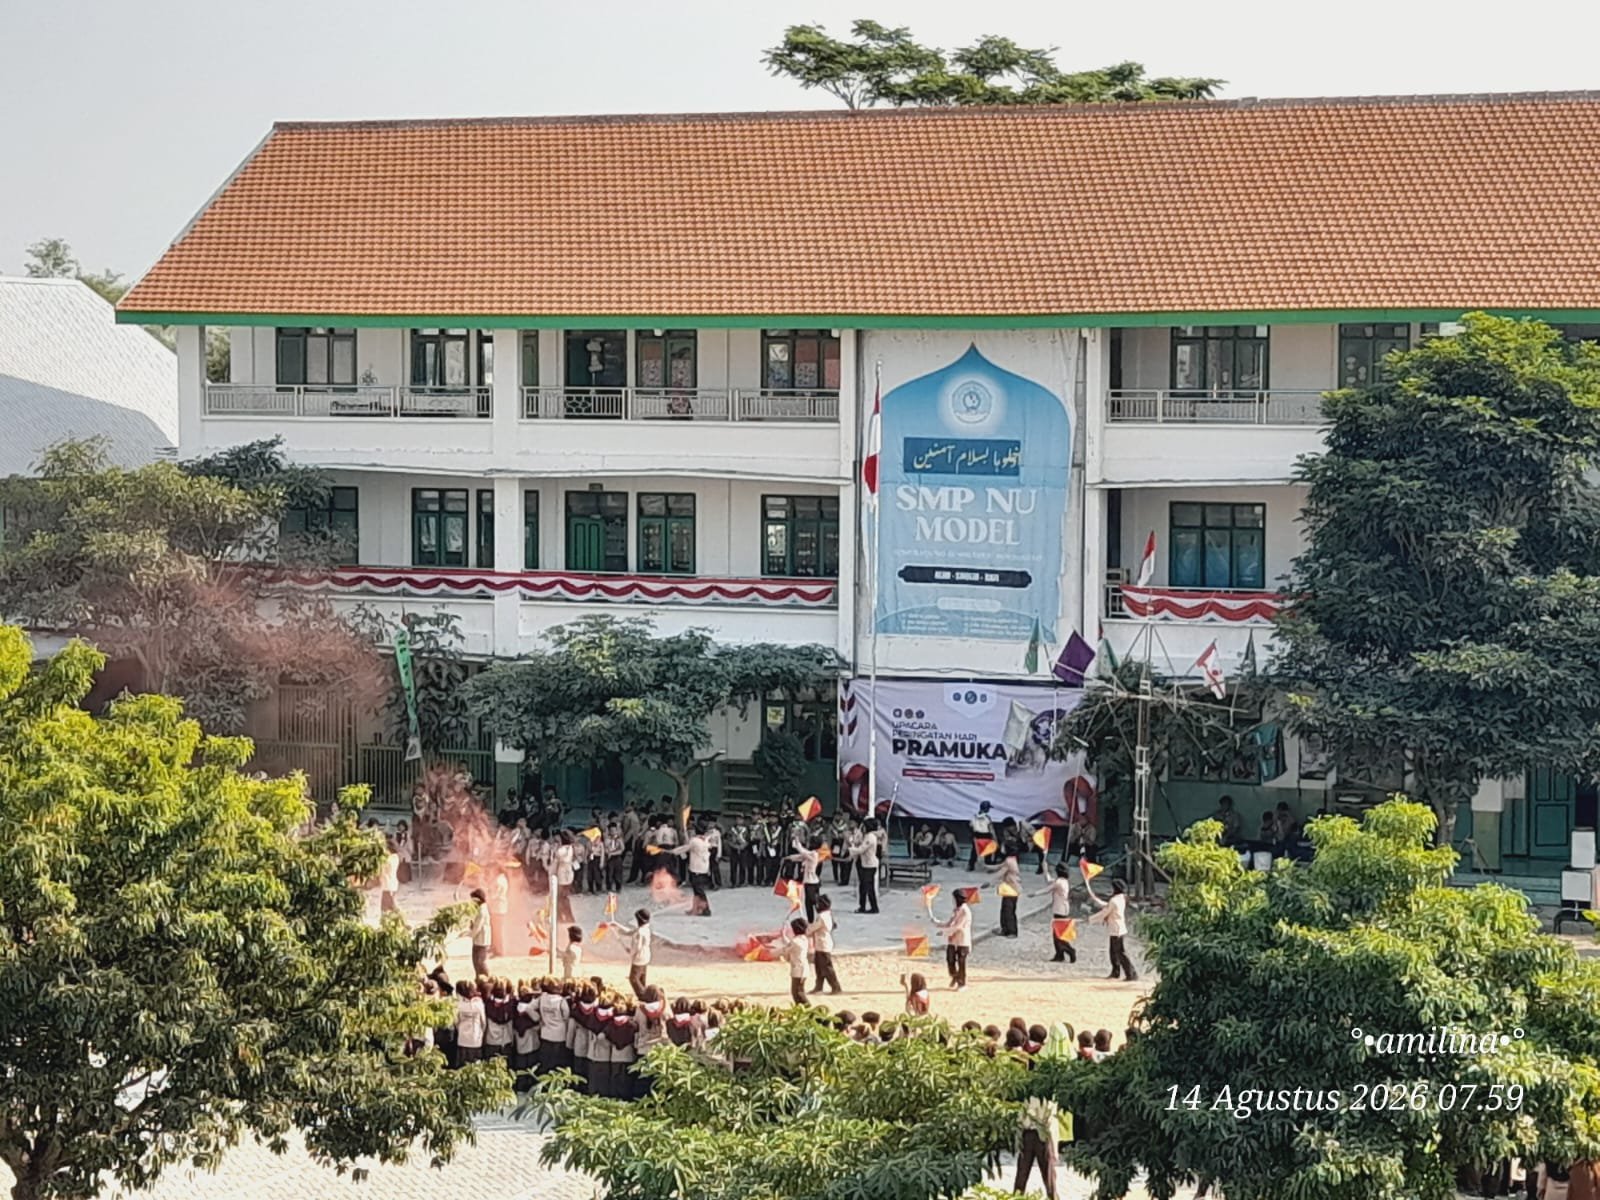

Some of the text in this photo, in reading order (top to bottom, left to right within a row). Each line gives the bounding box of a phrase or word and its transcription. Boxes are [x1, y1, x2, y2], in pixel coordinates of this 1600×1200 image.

[896, 485, 1037, 514] SMP NU
[915, 516, 1021, 545] MODEL
[892, 738, 1007, 761] PRAMUKA
